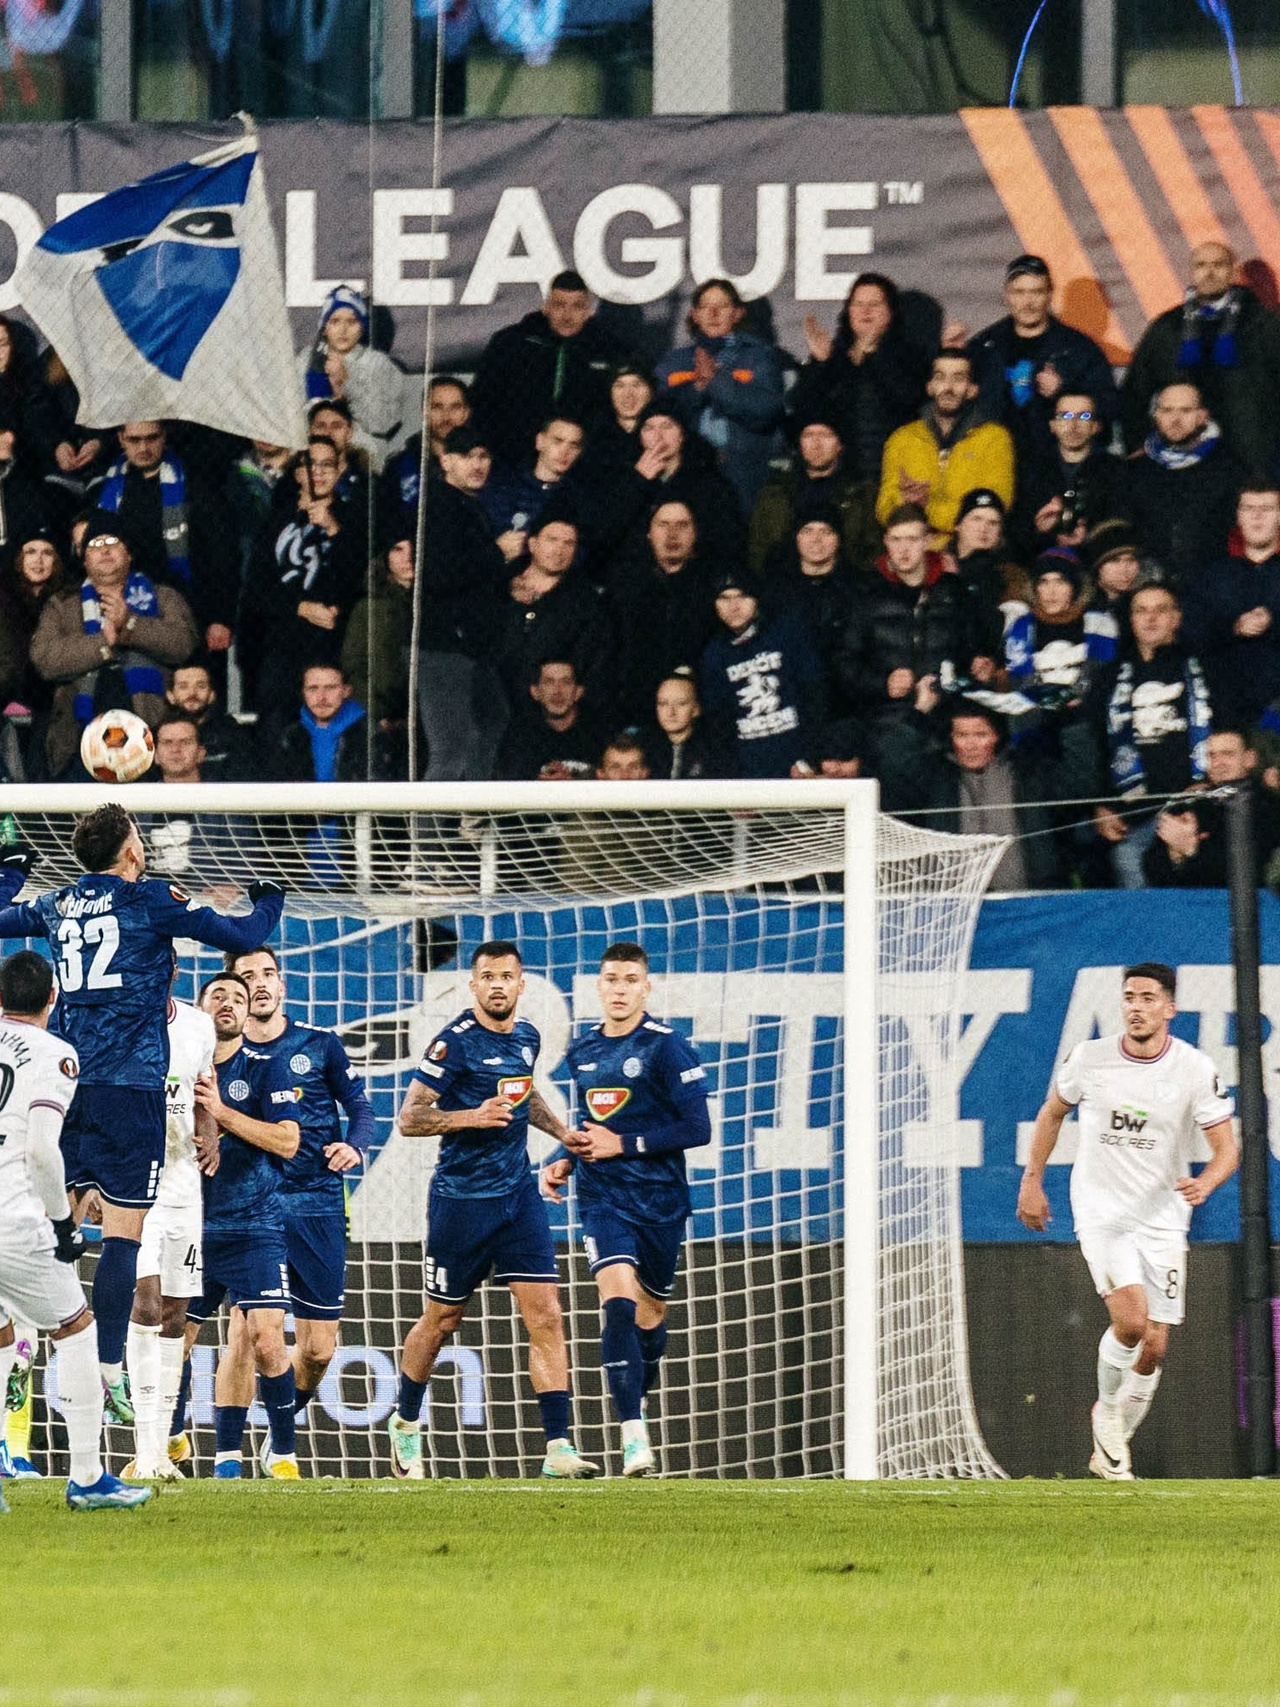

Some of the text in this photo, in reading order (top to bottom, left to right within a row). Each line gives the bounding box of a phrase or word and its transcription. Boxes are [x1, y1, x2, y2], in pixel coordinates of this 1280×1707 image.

[285, 181, 879, 307] LEAGUE
[57, 915, 123, 993] 32
[165, 1103, 187, 1115] RES
[183, 1243, 203, 1275] 4
[1165, 1268, 1179, 1300] 8
